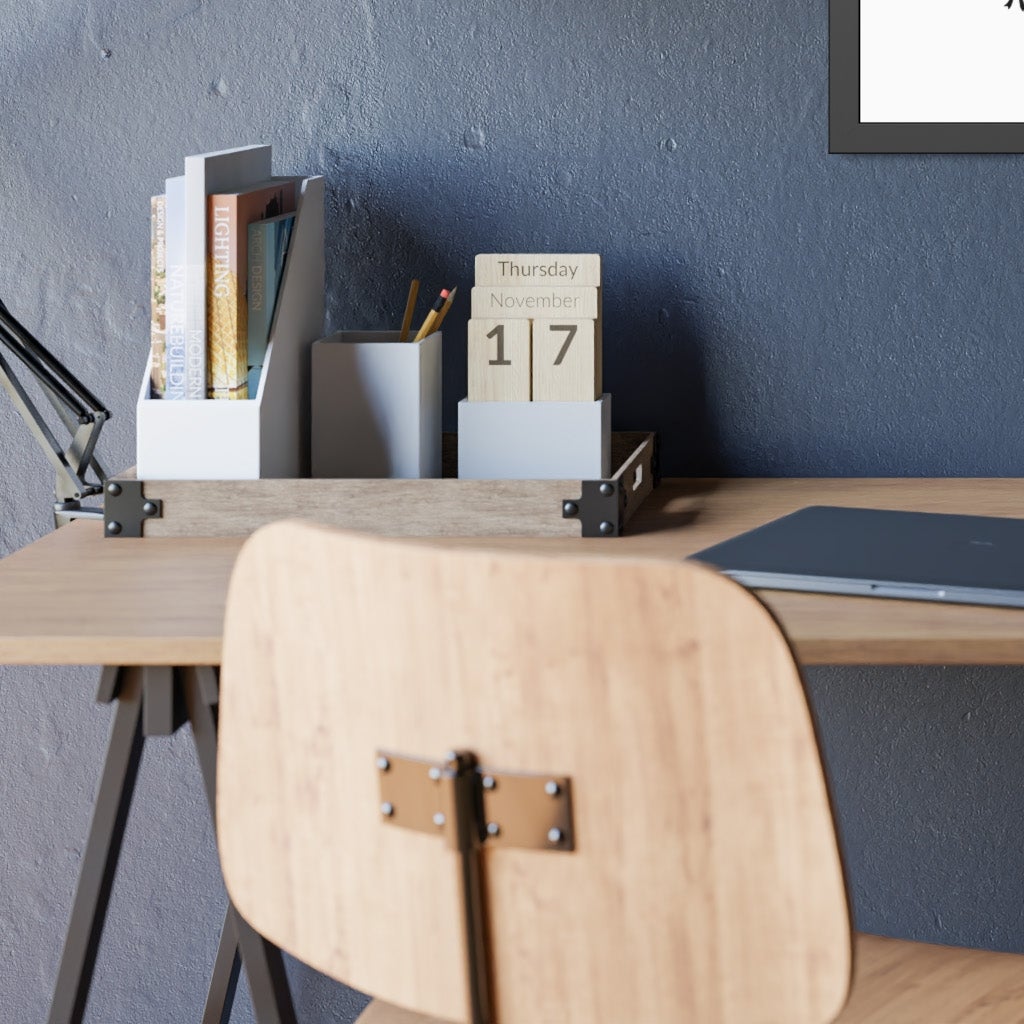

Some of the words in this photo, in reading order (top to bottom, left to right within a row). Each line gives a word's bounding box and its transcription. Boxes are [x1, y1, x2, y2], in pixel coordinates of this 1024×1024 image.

[214, 206, 230, 298] LIGHTING
[497, 260, 579, 280] Thursday
[251, 265, 263, 311] DESIGN
[490, 292, 580, 309] November
[188, 329, 203, 398] MODERN
